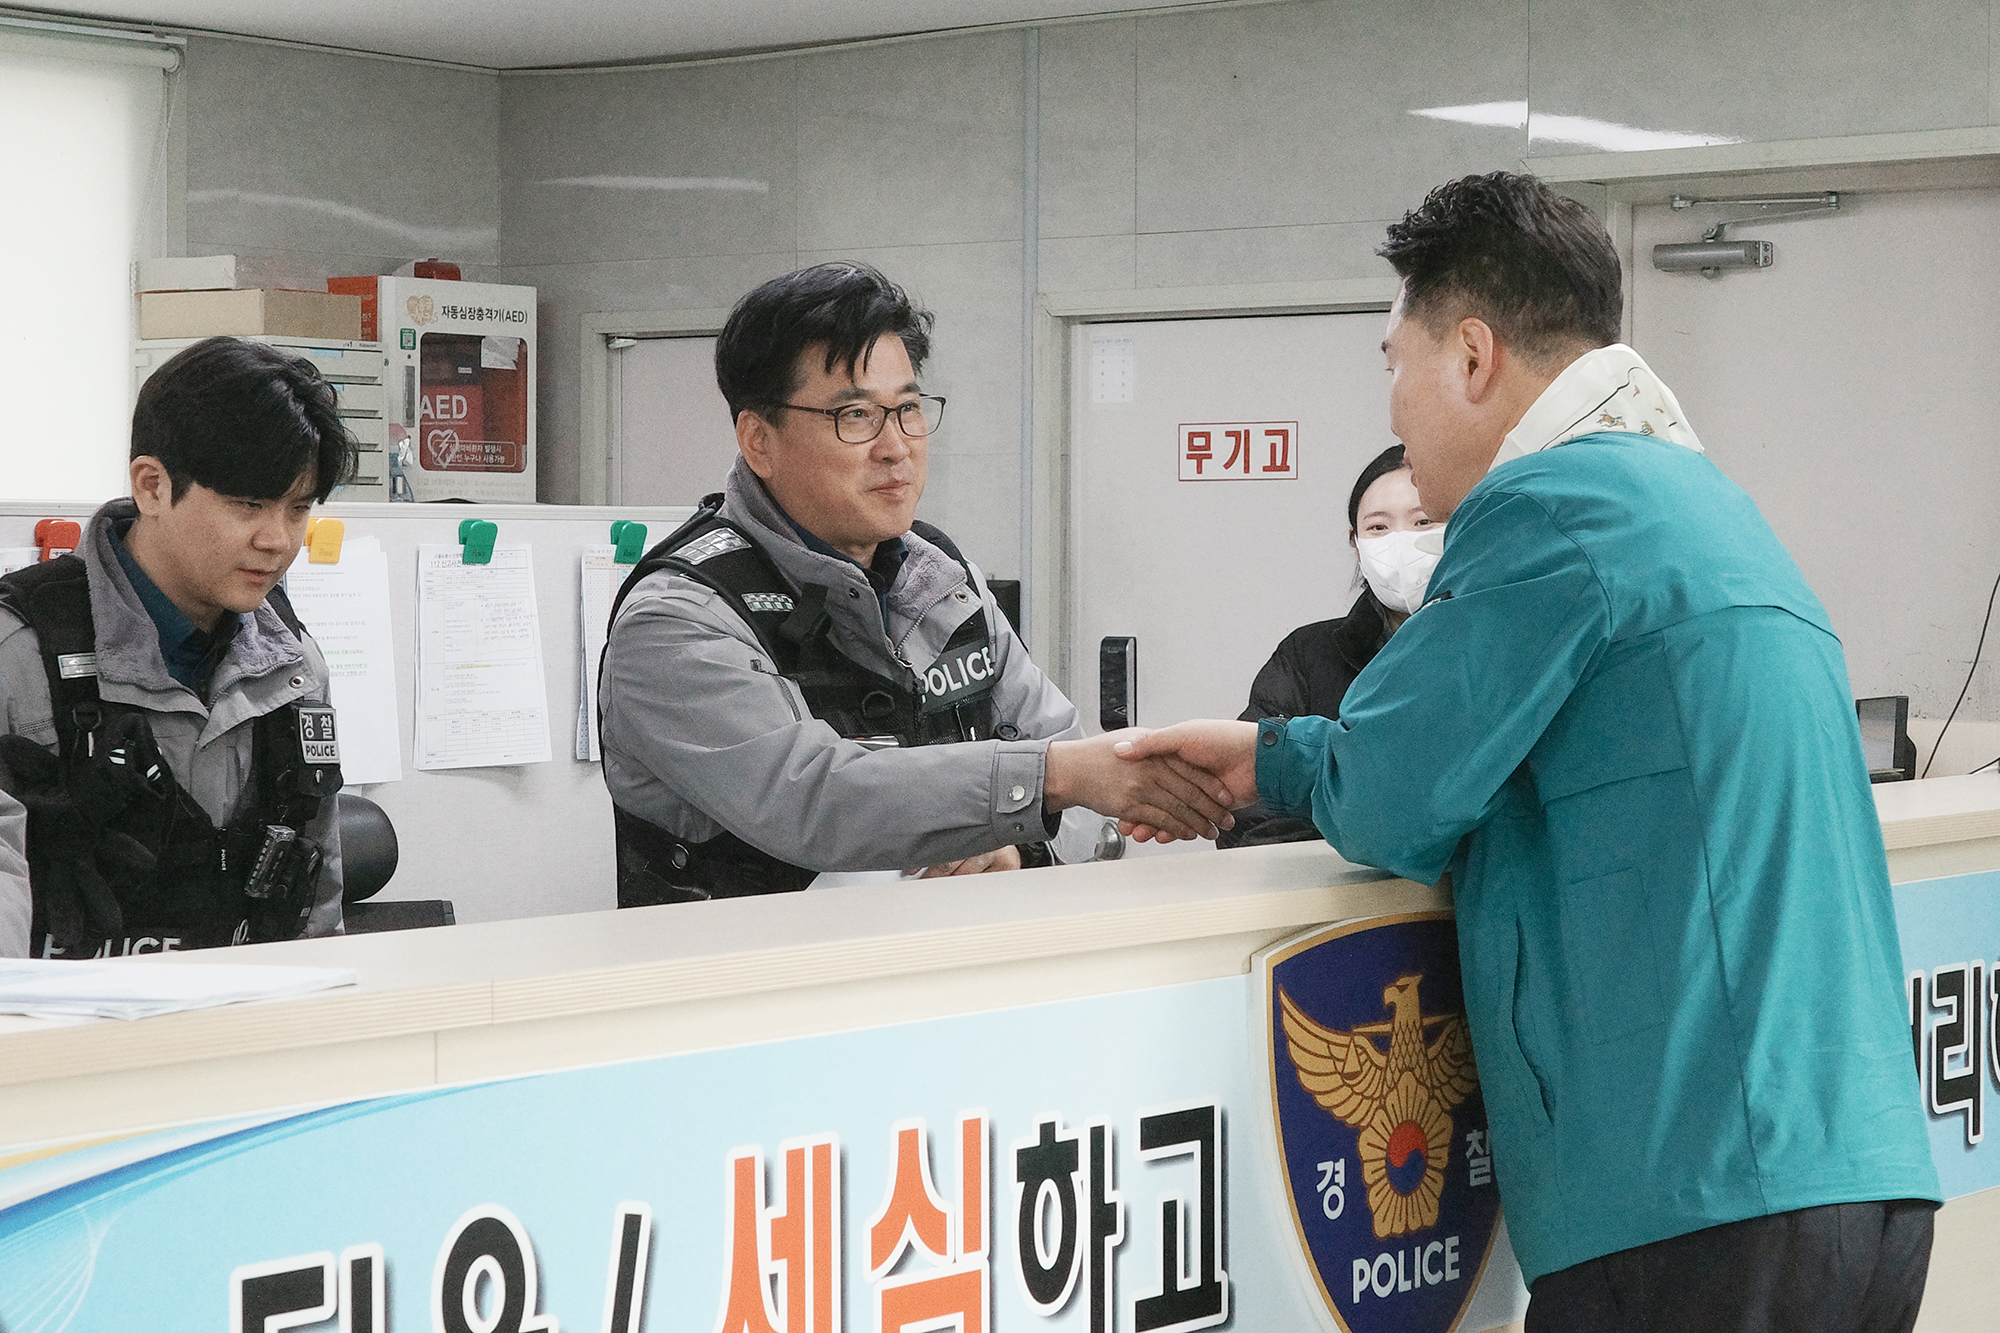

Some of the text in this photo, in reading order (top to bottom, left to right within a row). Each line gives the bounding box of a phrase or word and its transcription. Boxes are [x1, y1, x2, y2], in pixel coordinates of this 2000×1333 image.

[441, 304, 528, 324] 자동심장충격기(AED)
[420, 394, 468, 420] AED
[1186, 428, 1290, 475] 무기고
[306, 745, 336, 757] POLICE
[718, 1104, 1223, 1333] 세심하고
[1352, 1235, 1461, 1304] POLICE
